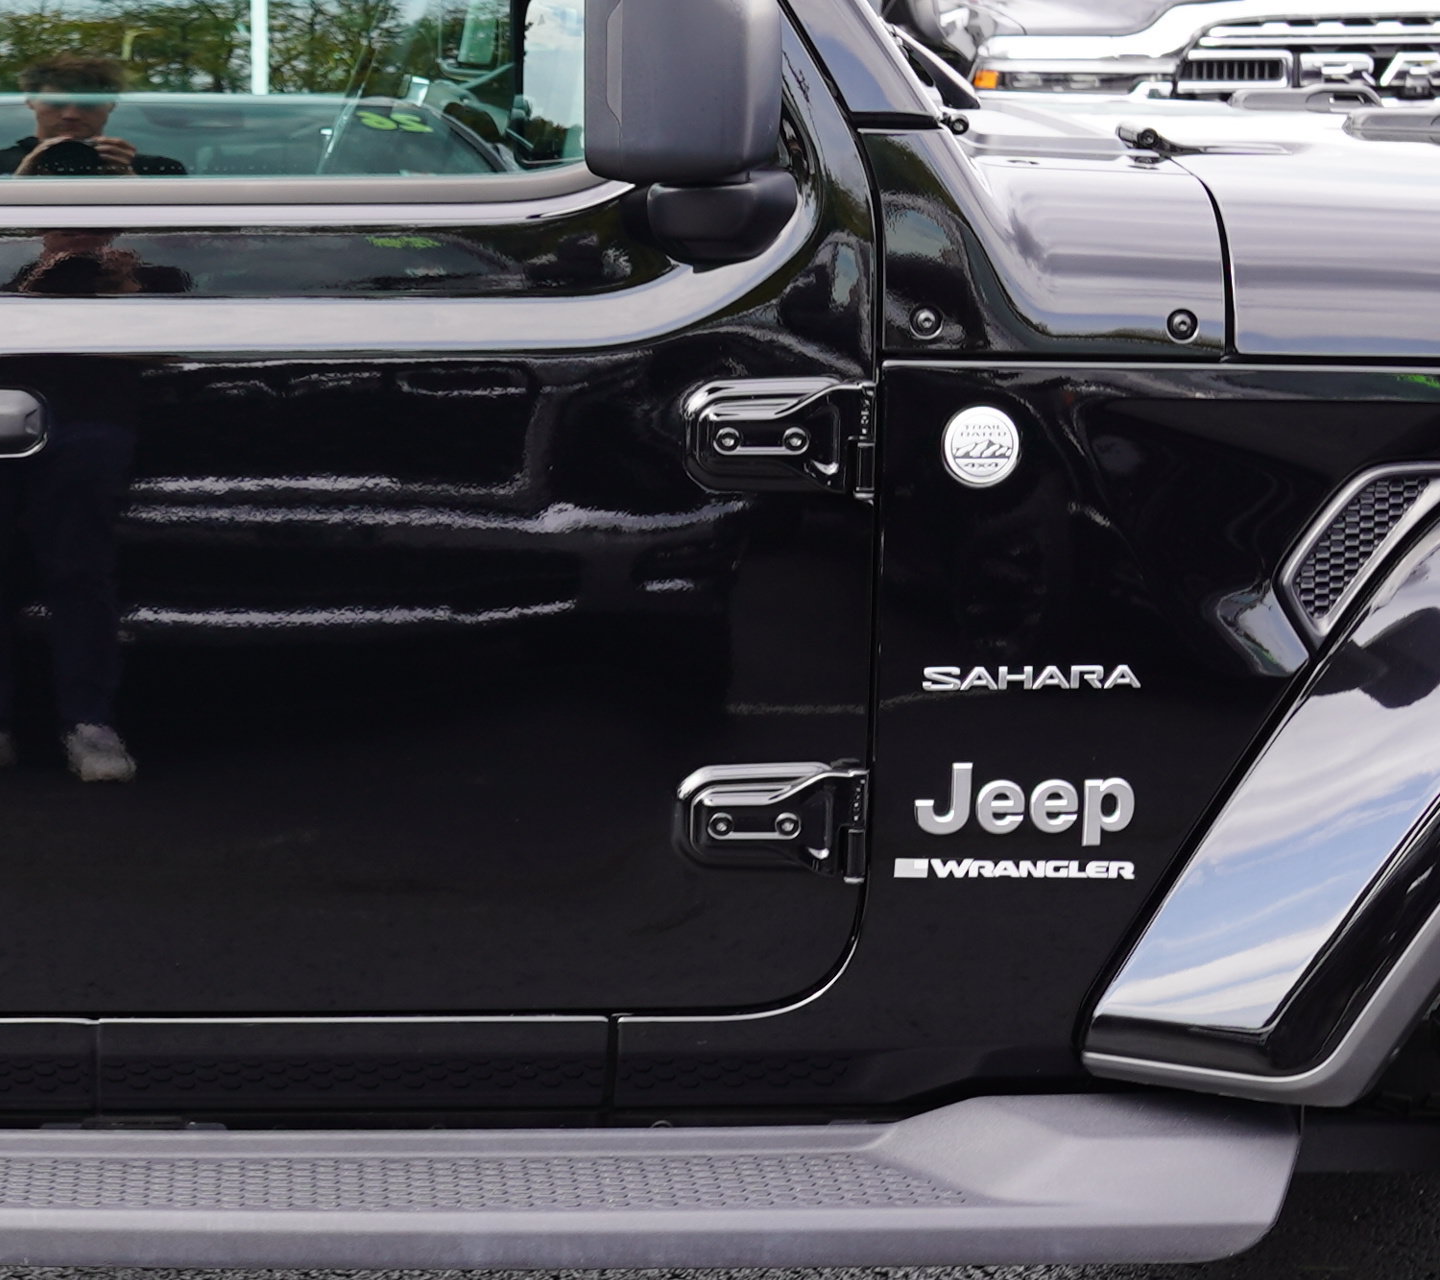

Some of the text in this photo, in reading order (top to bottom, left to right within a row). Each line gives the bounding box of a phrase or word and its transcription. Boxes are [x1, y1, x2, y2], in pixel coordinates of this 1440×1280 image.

[921, 664, 1142, 692] SAHARA
[914, 761, 1136, 847] Jeep
[931, 857, 1136, 881] WRANGLER
